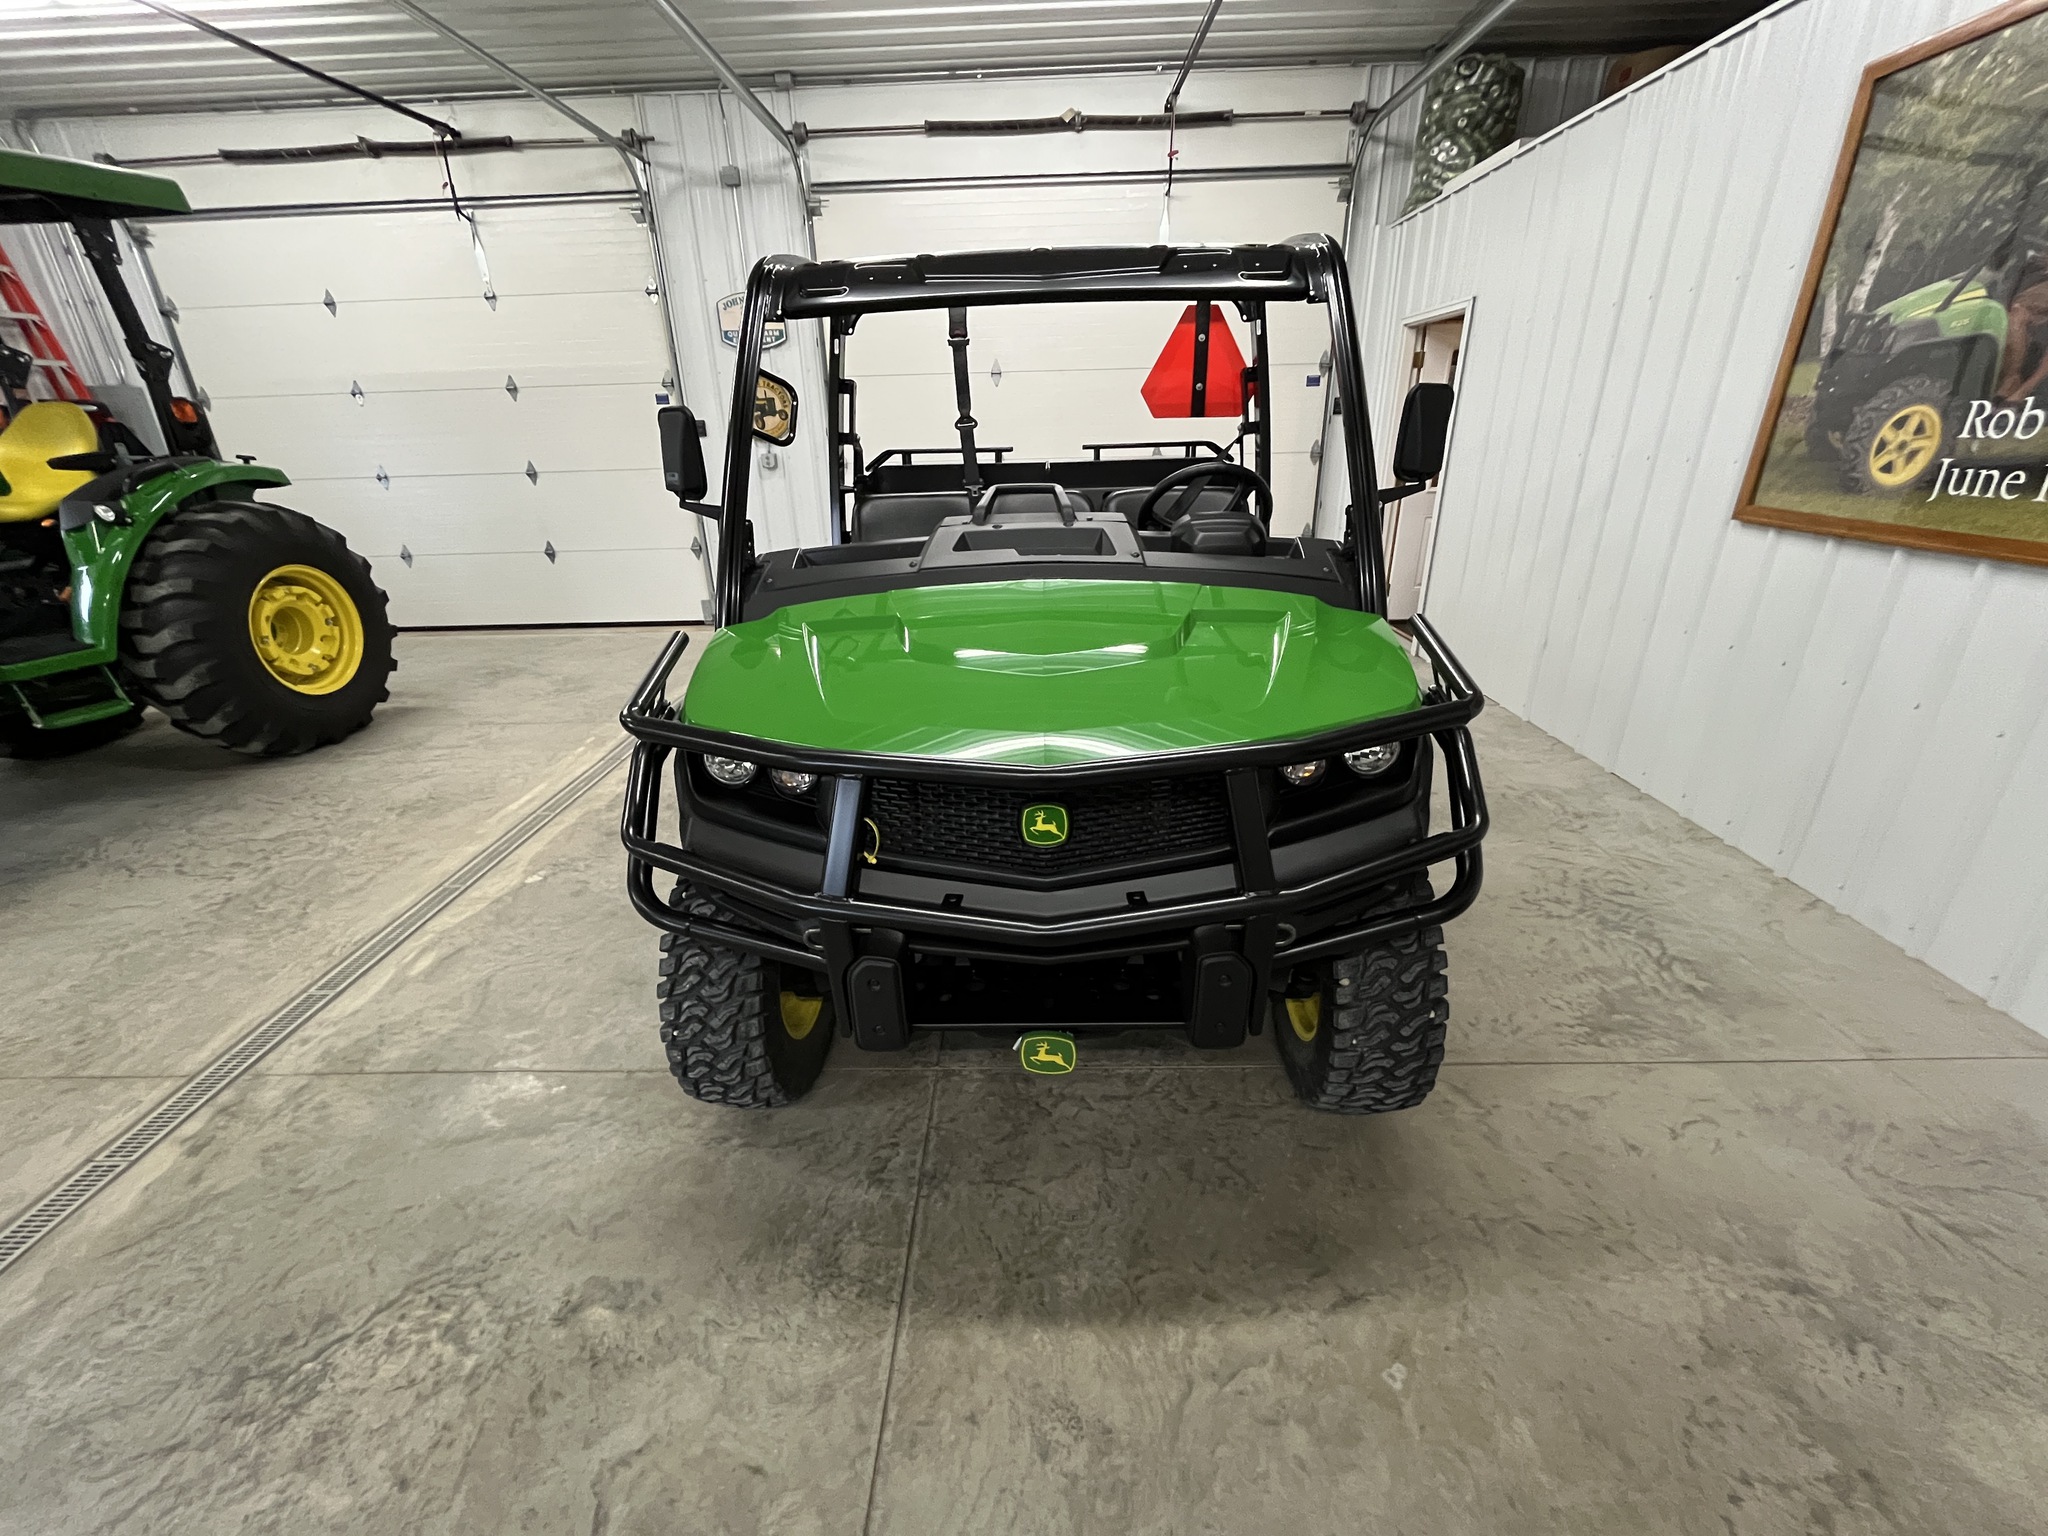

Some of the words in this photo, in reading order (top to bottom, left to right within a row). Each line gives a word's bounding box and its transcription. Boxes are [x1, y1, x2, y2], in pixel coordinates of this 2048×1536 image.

[722, 296, 745, 311] JOHN
[762, 380, 788, 409] TRACTORS
[1956, 396, 2046, 440] Rob
[1926, 458, 2027, 503] June
